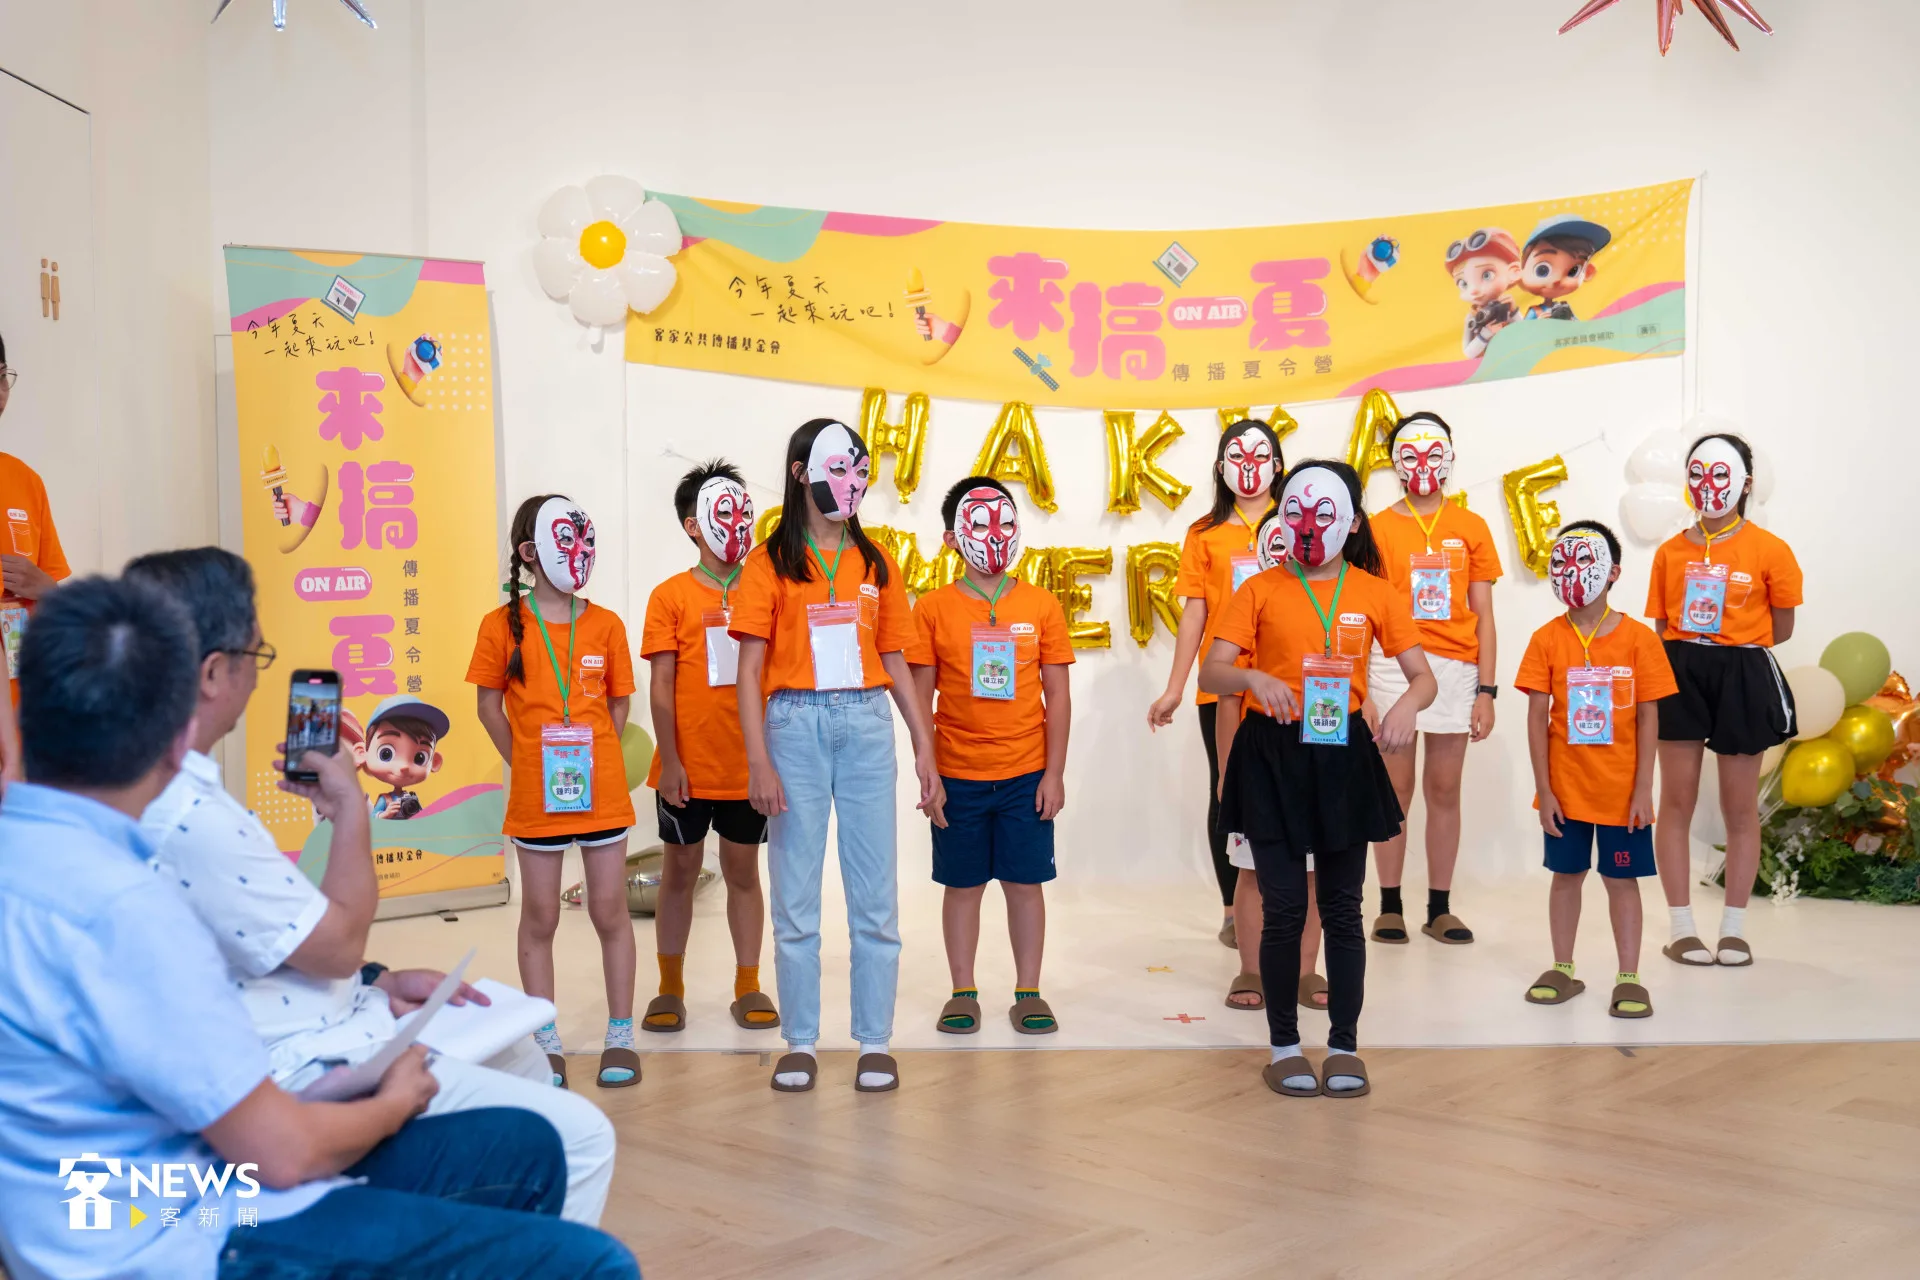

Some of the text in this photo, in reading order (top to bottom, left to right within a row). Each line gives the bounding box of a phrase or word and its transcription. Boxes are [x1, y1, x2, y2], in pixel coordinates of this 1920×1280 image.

[728, 275, 829, 300] 今年夏天
[1173, 304, 1243, 321] ON AIR
[1249, 257, 1332, 352] 夏
[246, 312, 325, 340] 今年夏天
[654, 327, 781, 355] 客家公共傳播基金會
[1171, 354, 1333, 383] 傳播夏令營
[301, 575, 366, 593] ON AIR
[402, 559, 422, 694] 傳播夏令營
[329, 614, 398, 698] 夏
[1614, 851, 1631, 865] 03
